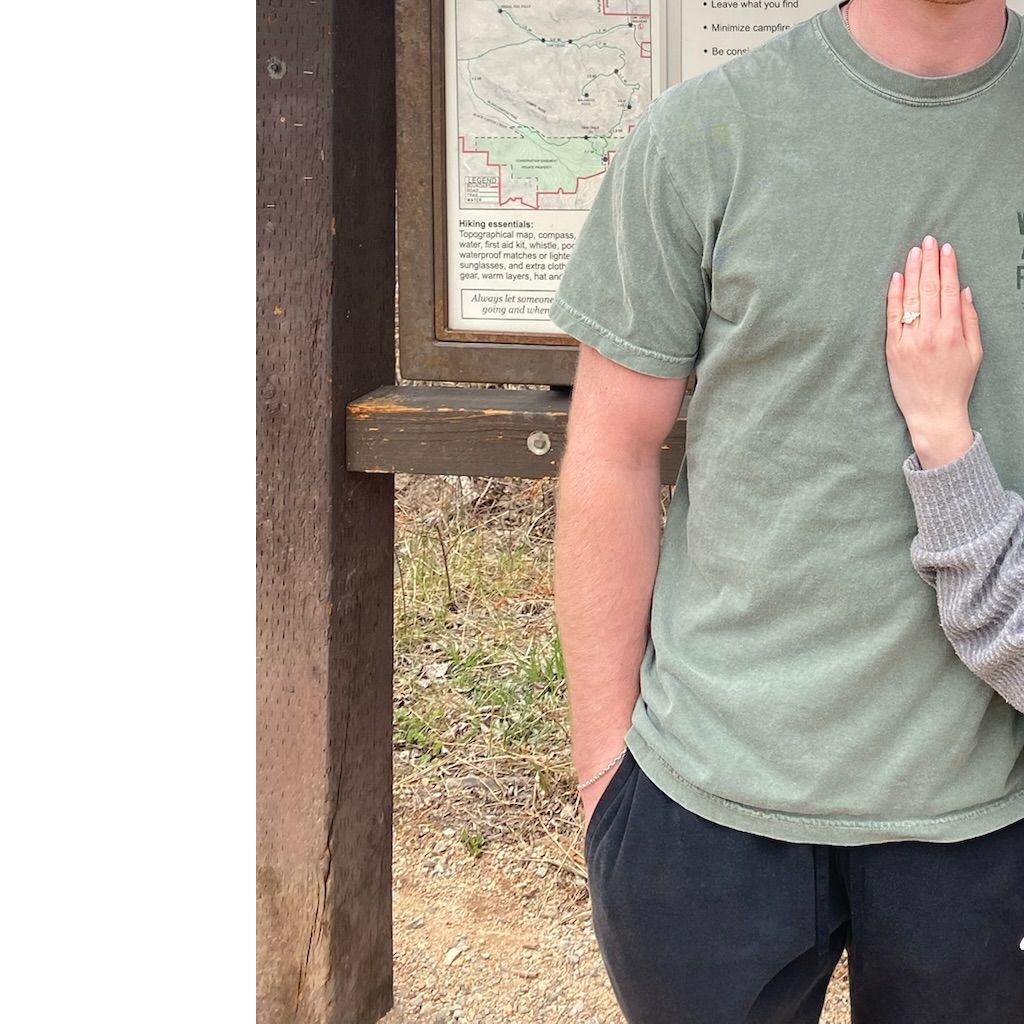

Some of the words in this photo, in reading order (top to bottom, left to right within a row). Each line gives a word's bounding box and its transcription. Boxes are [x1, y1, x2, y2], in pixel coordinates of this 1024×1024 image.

[711, 0, 738, 8] Leave
[740, 0, 761, 8] what
[763, 1, 780, 10] you
[782, 0, 798, 8] find
[711, 23, 750, 32] Minimize
[459, 220, 485, 229] Hiking
[487, 220, 533, 228] essentials:
[459, 230, 514, 240] Topographical
[515, 232, 535, 240] map,
[537, 232, 576, 240] compass,
